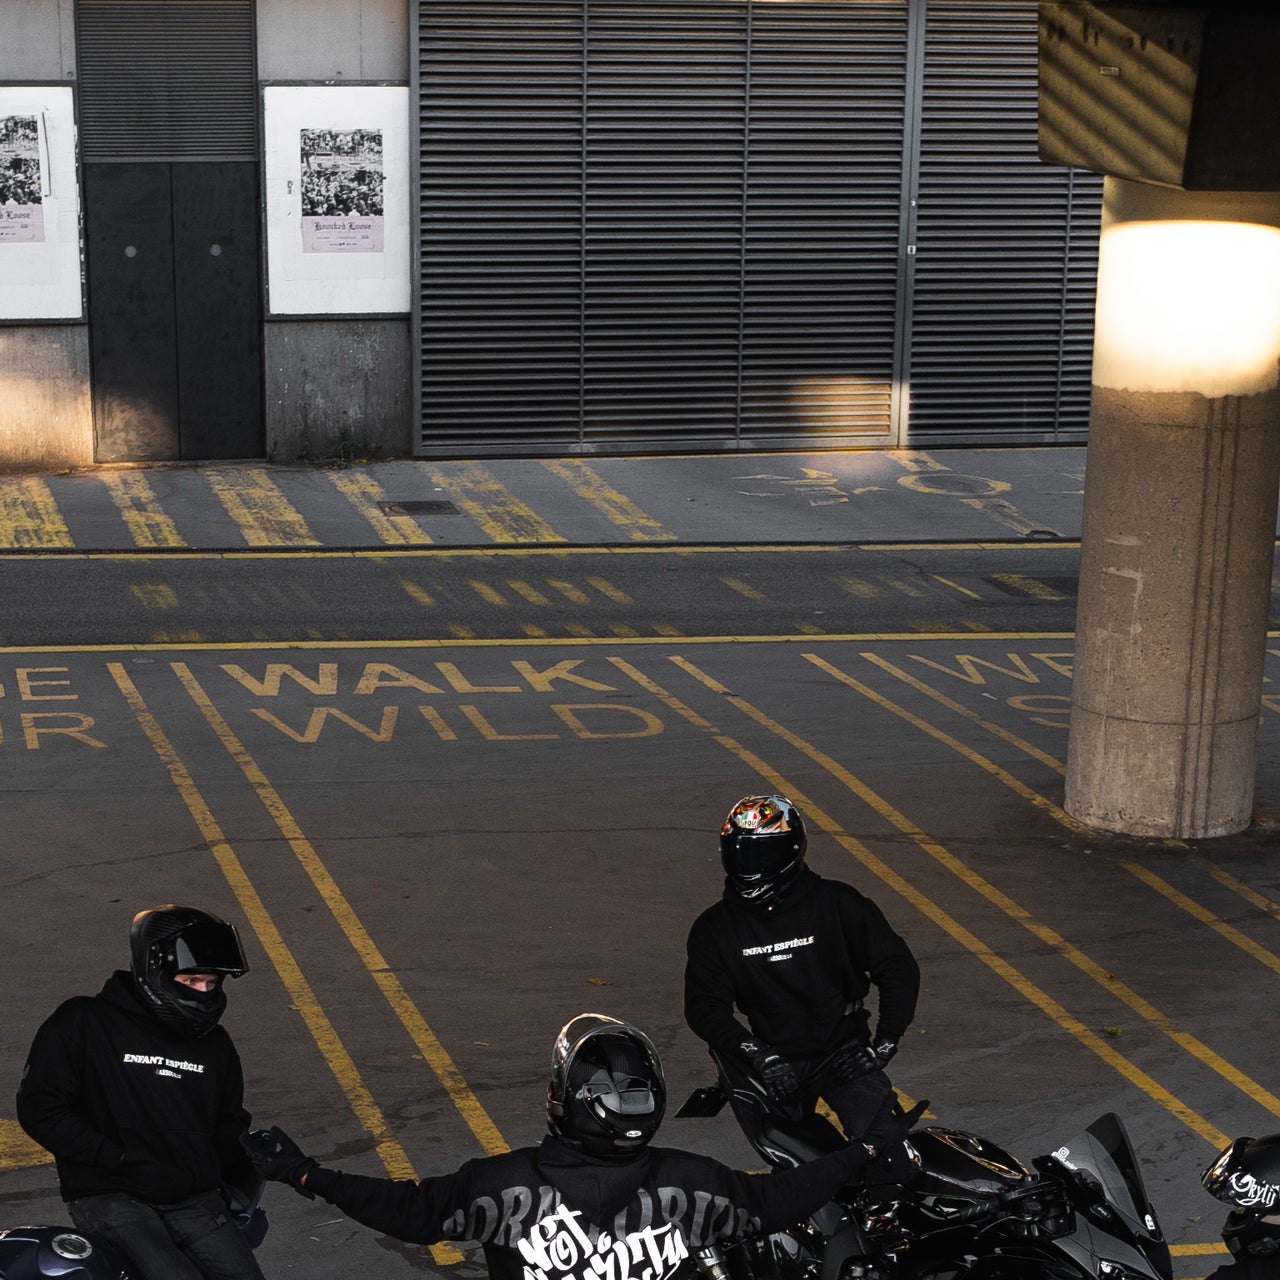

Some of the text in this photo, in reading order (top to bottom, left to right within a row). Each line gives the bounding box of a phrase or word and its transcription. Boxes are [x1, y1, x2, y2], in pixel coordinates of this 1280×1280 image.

[219, 659, 619, 697] WALK
[249, 704, 665, 744] WILD
[123, 1053, 204, 1074] ENFANT ESPIÈGLE
